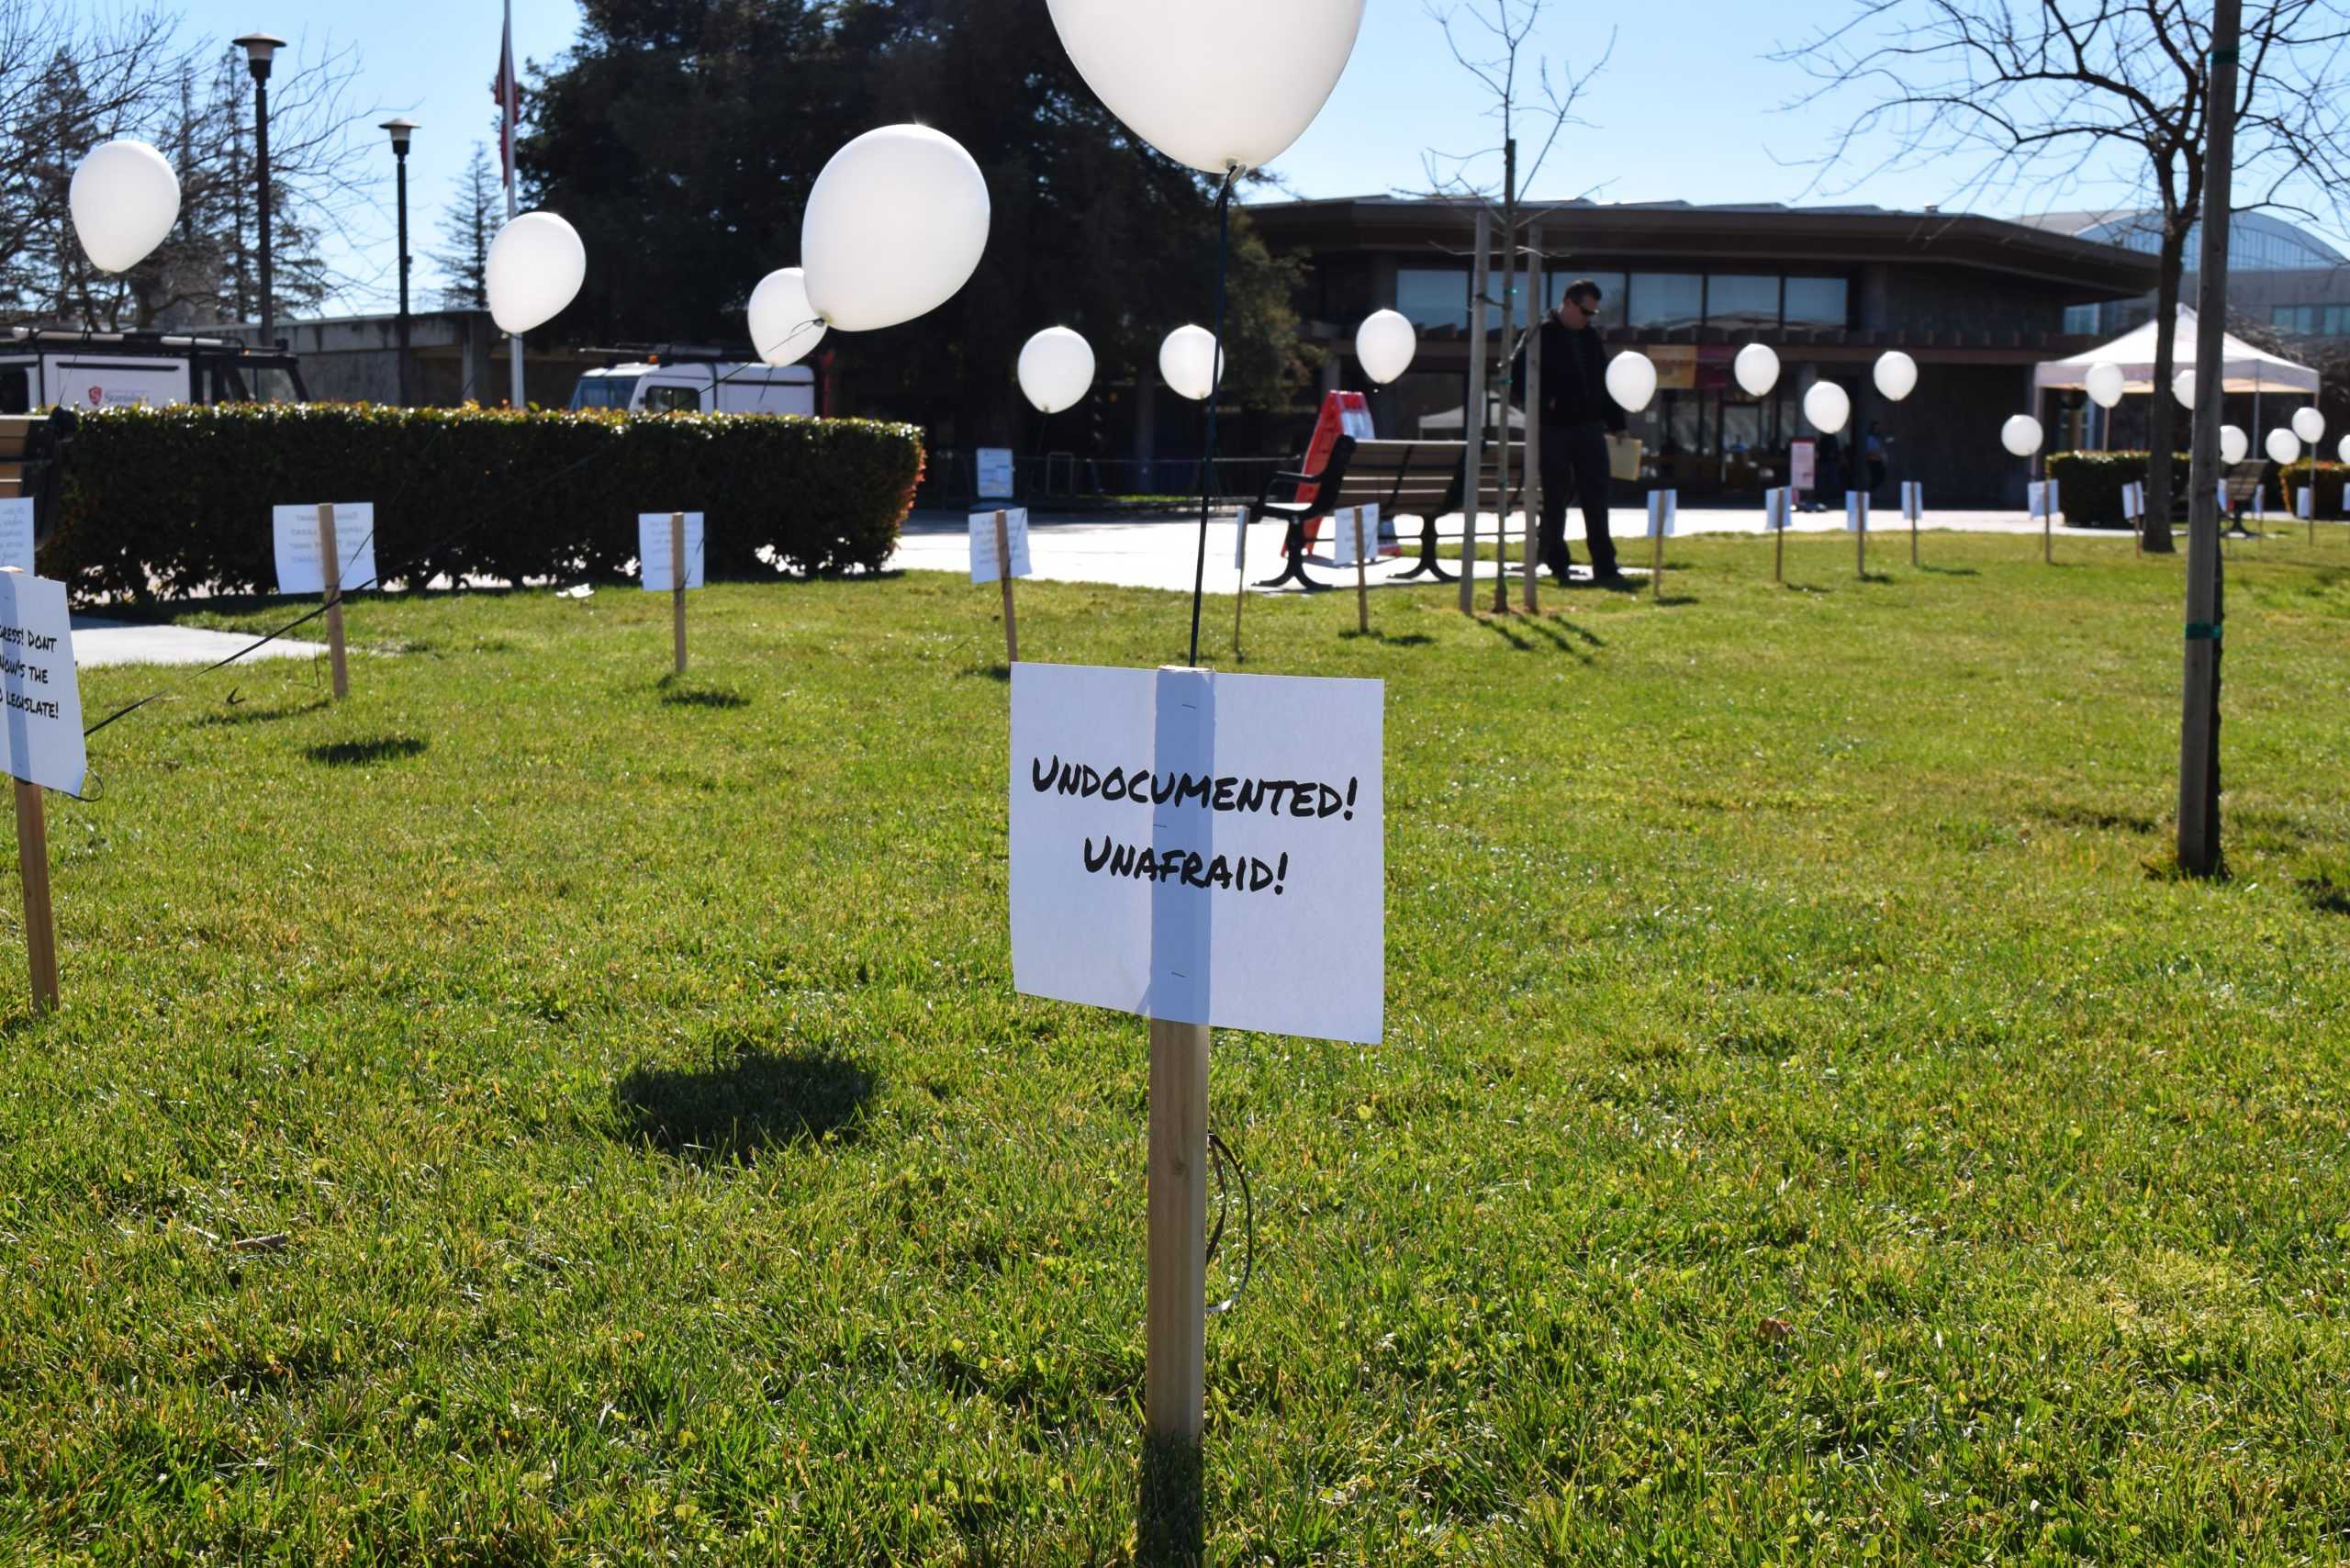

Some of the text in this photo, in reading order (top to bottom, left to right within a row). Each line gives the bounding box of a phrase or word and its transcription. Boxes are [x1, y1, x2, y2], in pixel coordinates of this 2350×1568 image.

[28, 629, 57, 653] DONT
[28, 666, 49, 684] THE
[6, 689, 59, 720] LEGISLATE!
[1033, 756, 1357, 821] UNDOCUMENTED!
[1084, 836, 1288, 894] UNAFRAID!
